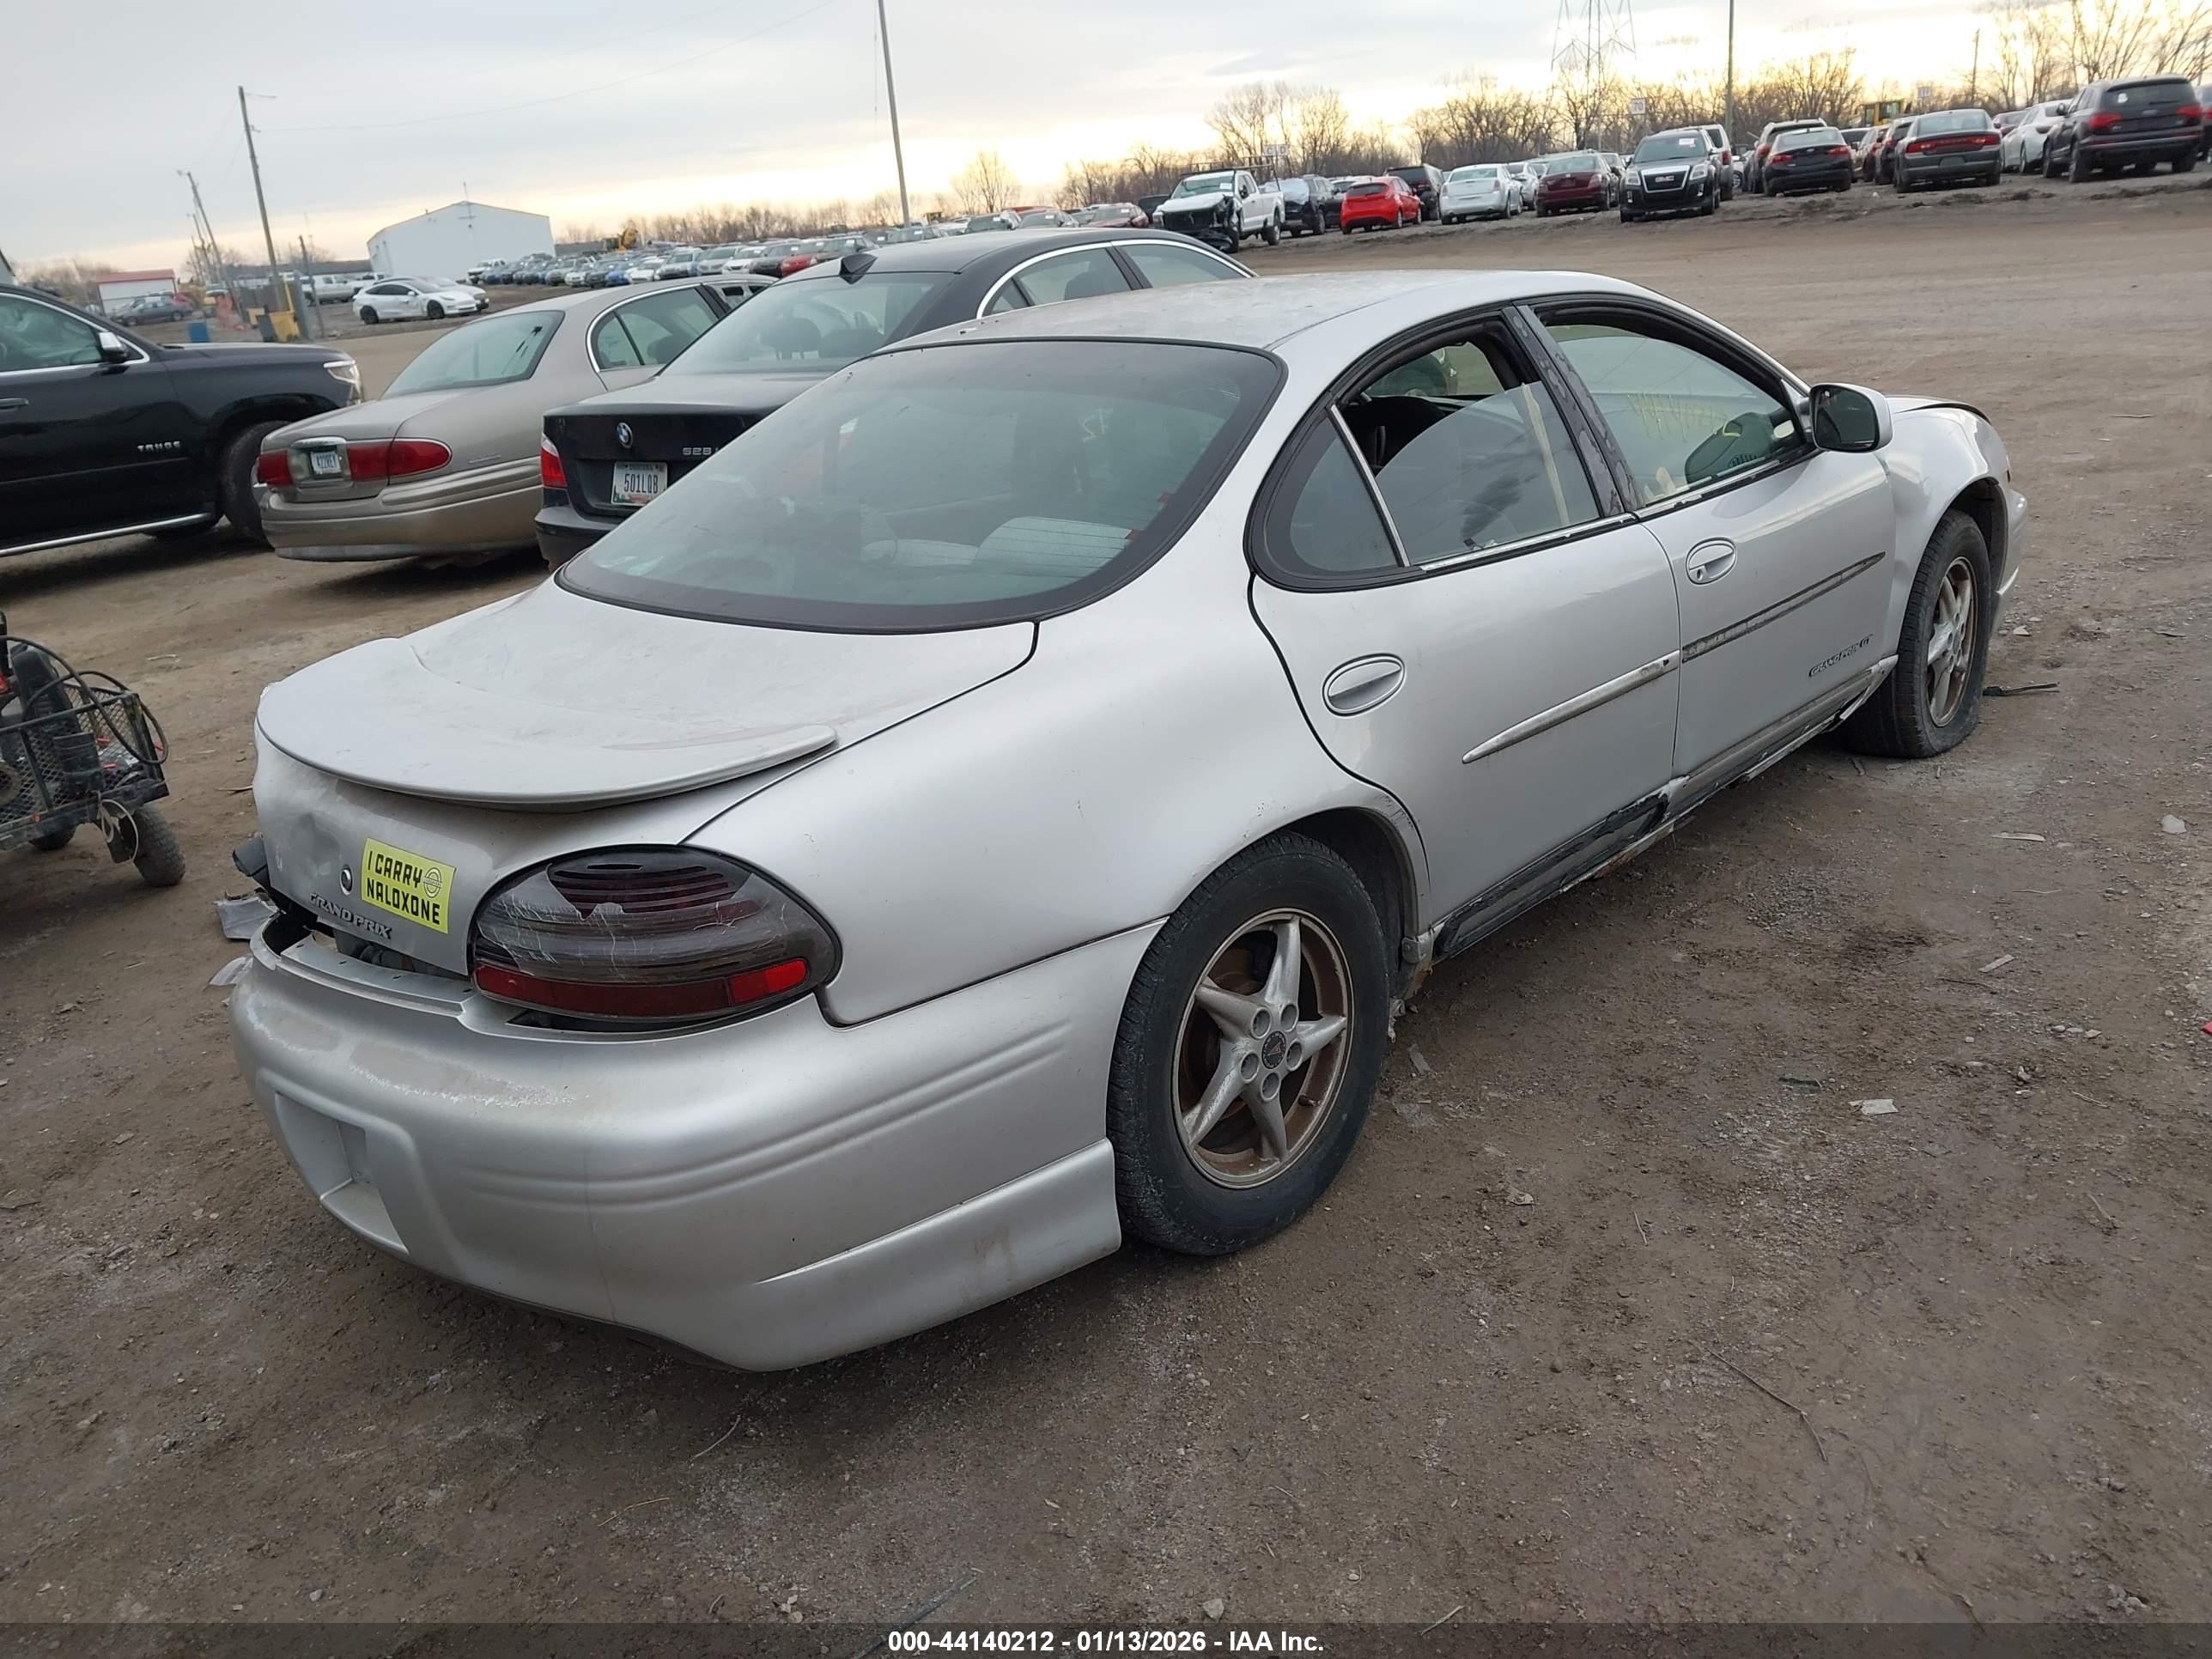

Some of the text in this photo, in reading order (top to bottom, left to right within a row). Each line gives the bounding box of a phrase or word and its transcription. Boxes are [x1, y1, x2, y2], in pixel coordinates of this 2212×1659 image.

[137, 441, 181, 453] TAHOE
[368, 850, 373, 871] I
[374, 853, 423, 889] CARRY
[367, 878, 441, 925] NALOXONE
[353, 915, 392, 939] PRIX
